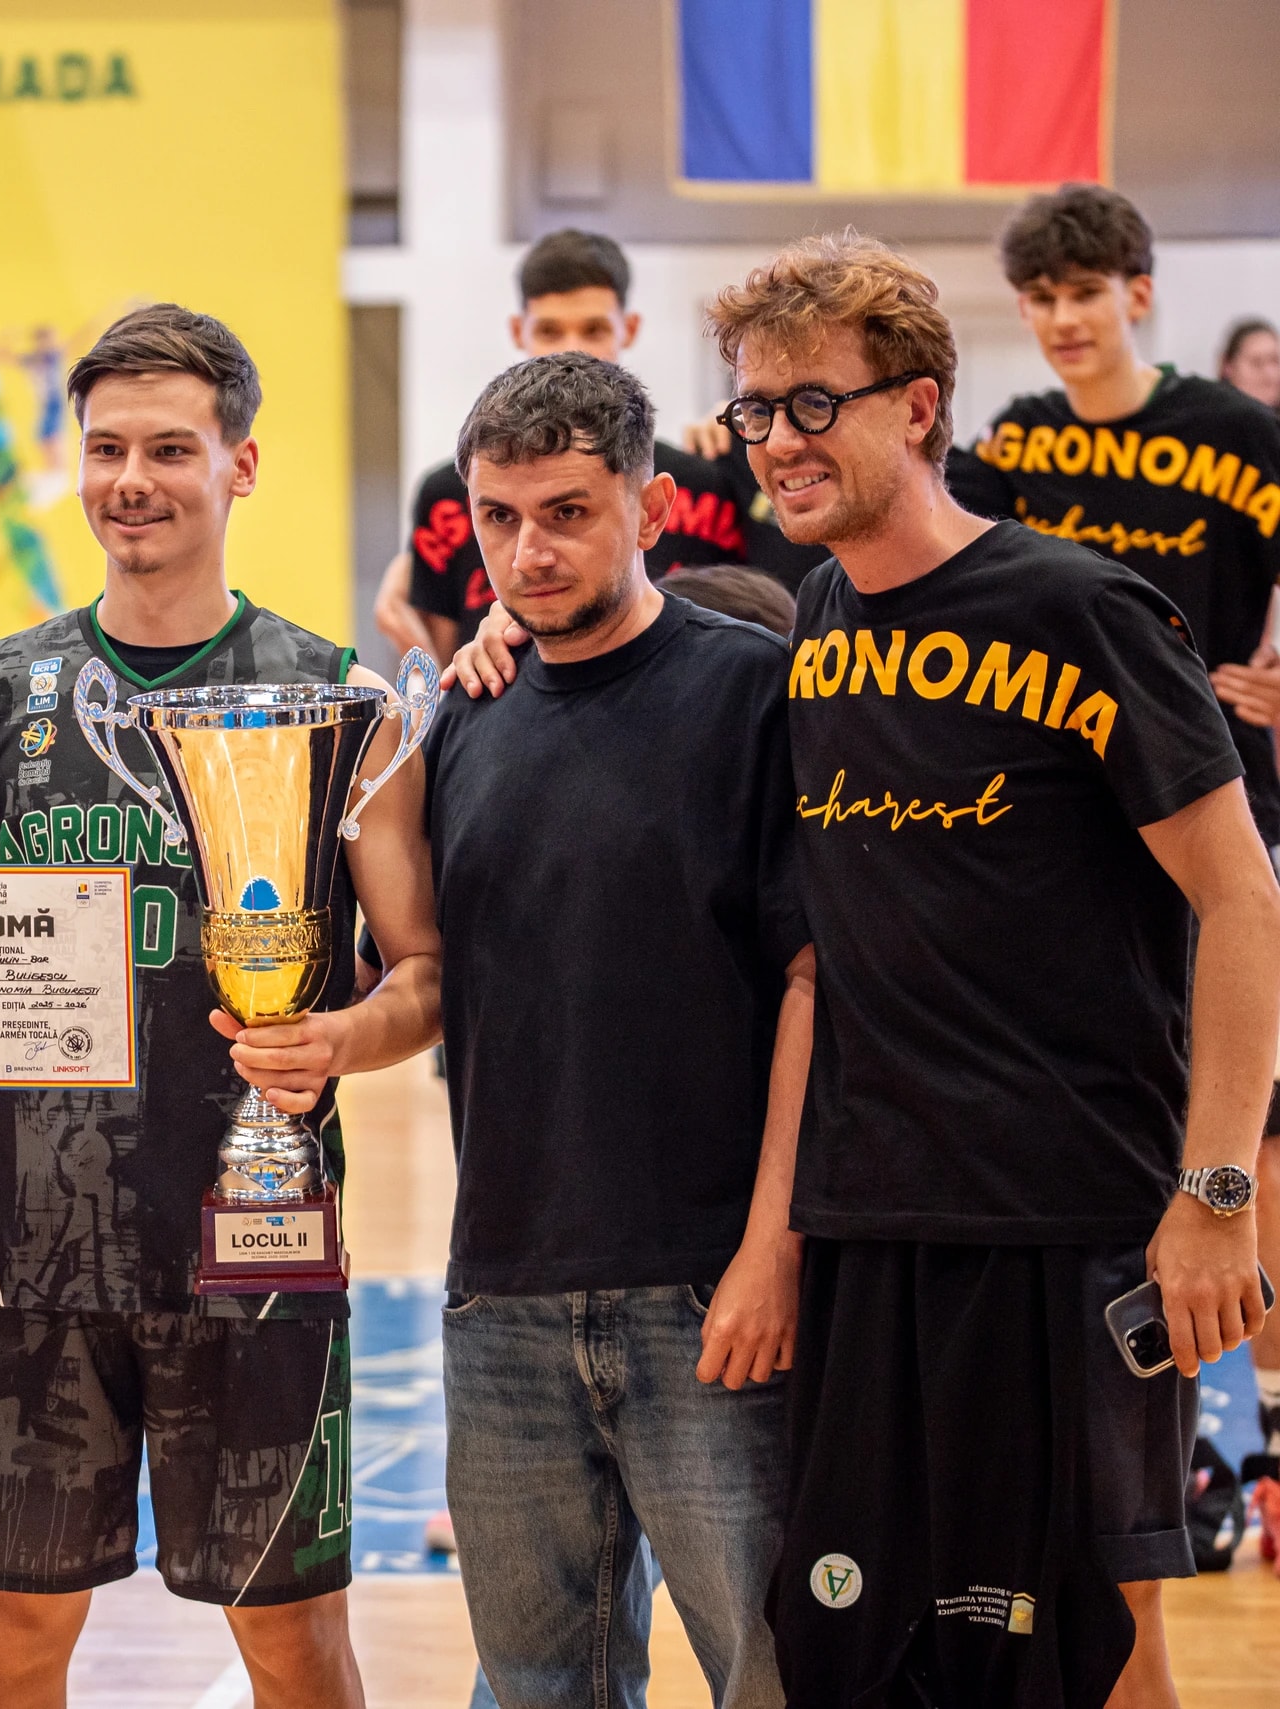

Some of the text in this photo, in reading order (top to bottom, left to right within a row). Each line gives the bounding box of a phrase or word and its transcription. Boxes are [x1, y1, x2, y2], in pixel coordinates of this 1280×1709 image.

[35, 696, 51, 706] LIM
[788, 629, 1119, 762] RONOMIA
[797, 769, 1013, 831] charest
[2, 1001, 26, 1012] EDIȚIA
[29, 1029, 58, 1039] TOCALĂ
[231, 1232, 293, 1248] LOCUL
[319, 1402, 352, 1539] 1
